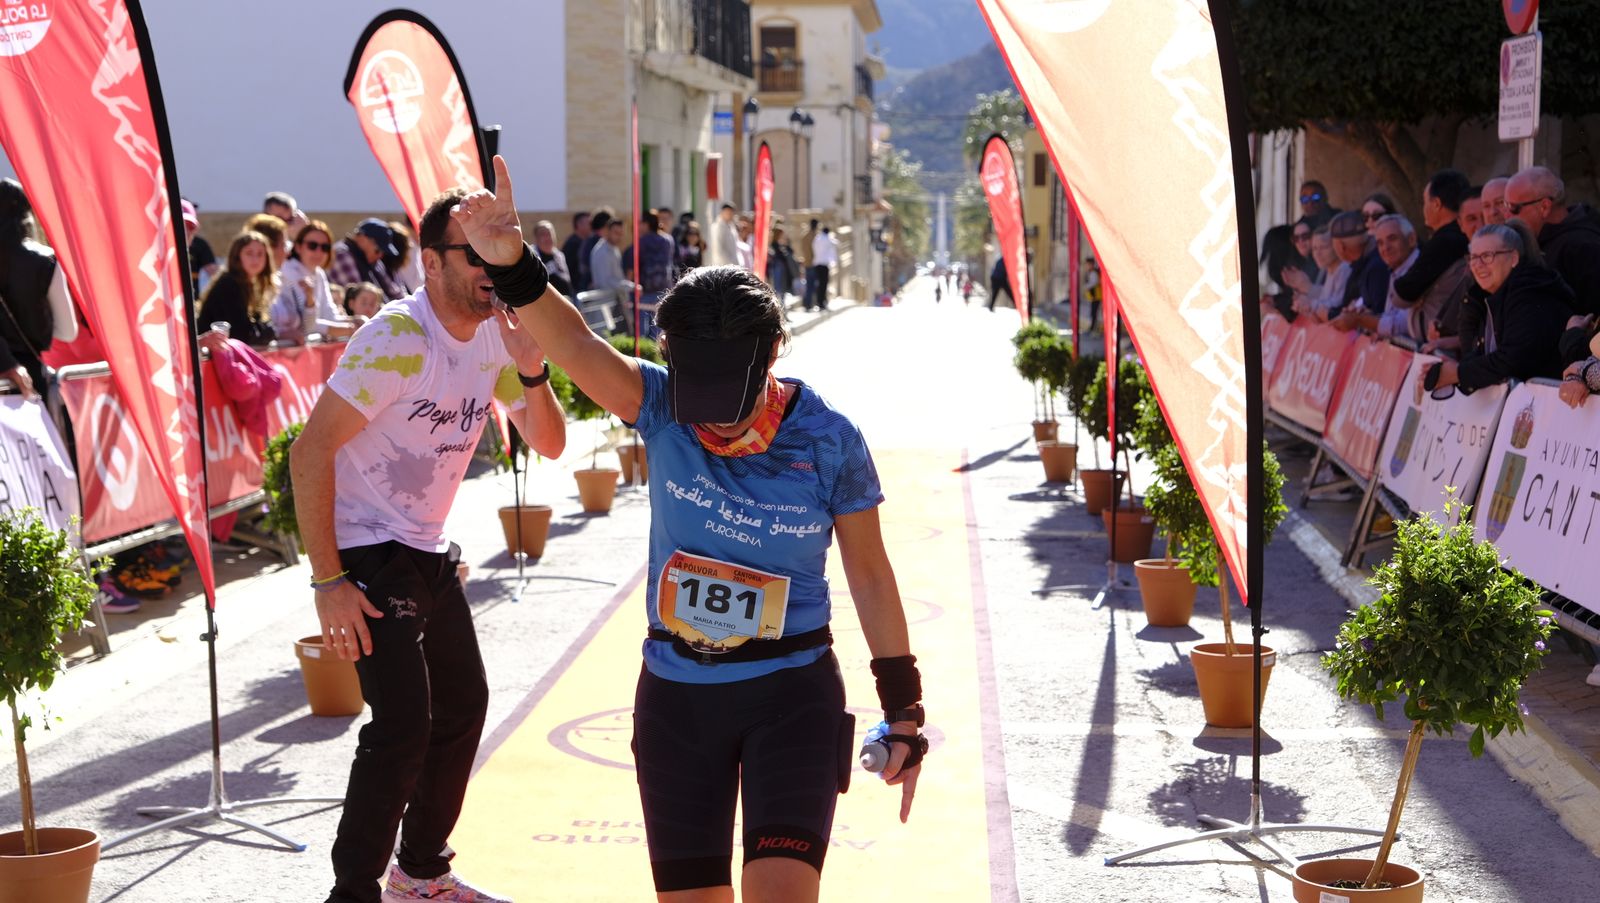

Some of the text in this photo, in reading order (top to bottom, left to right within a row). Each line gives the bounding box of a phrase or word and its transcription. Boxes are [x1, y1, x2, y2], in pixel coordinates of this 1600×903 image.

[407, 398, 458, 435] Pepe
[665, 479, 713, 509] media
[717, 500, 762, 528] legua
[744, 498, 755, 508] de
[777, 504, 808, 515] Humeya
[704, 519, 762, 549] PURCHENA
[674, 560, 682, 569] LA
[733, 569, 763, 583] CANTORIA
[680, 577, 758, 621] 181
[693, 614, 737, 631] MARIA PATRO
[756, 836, 811, 852] HOKO
